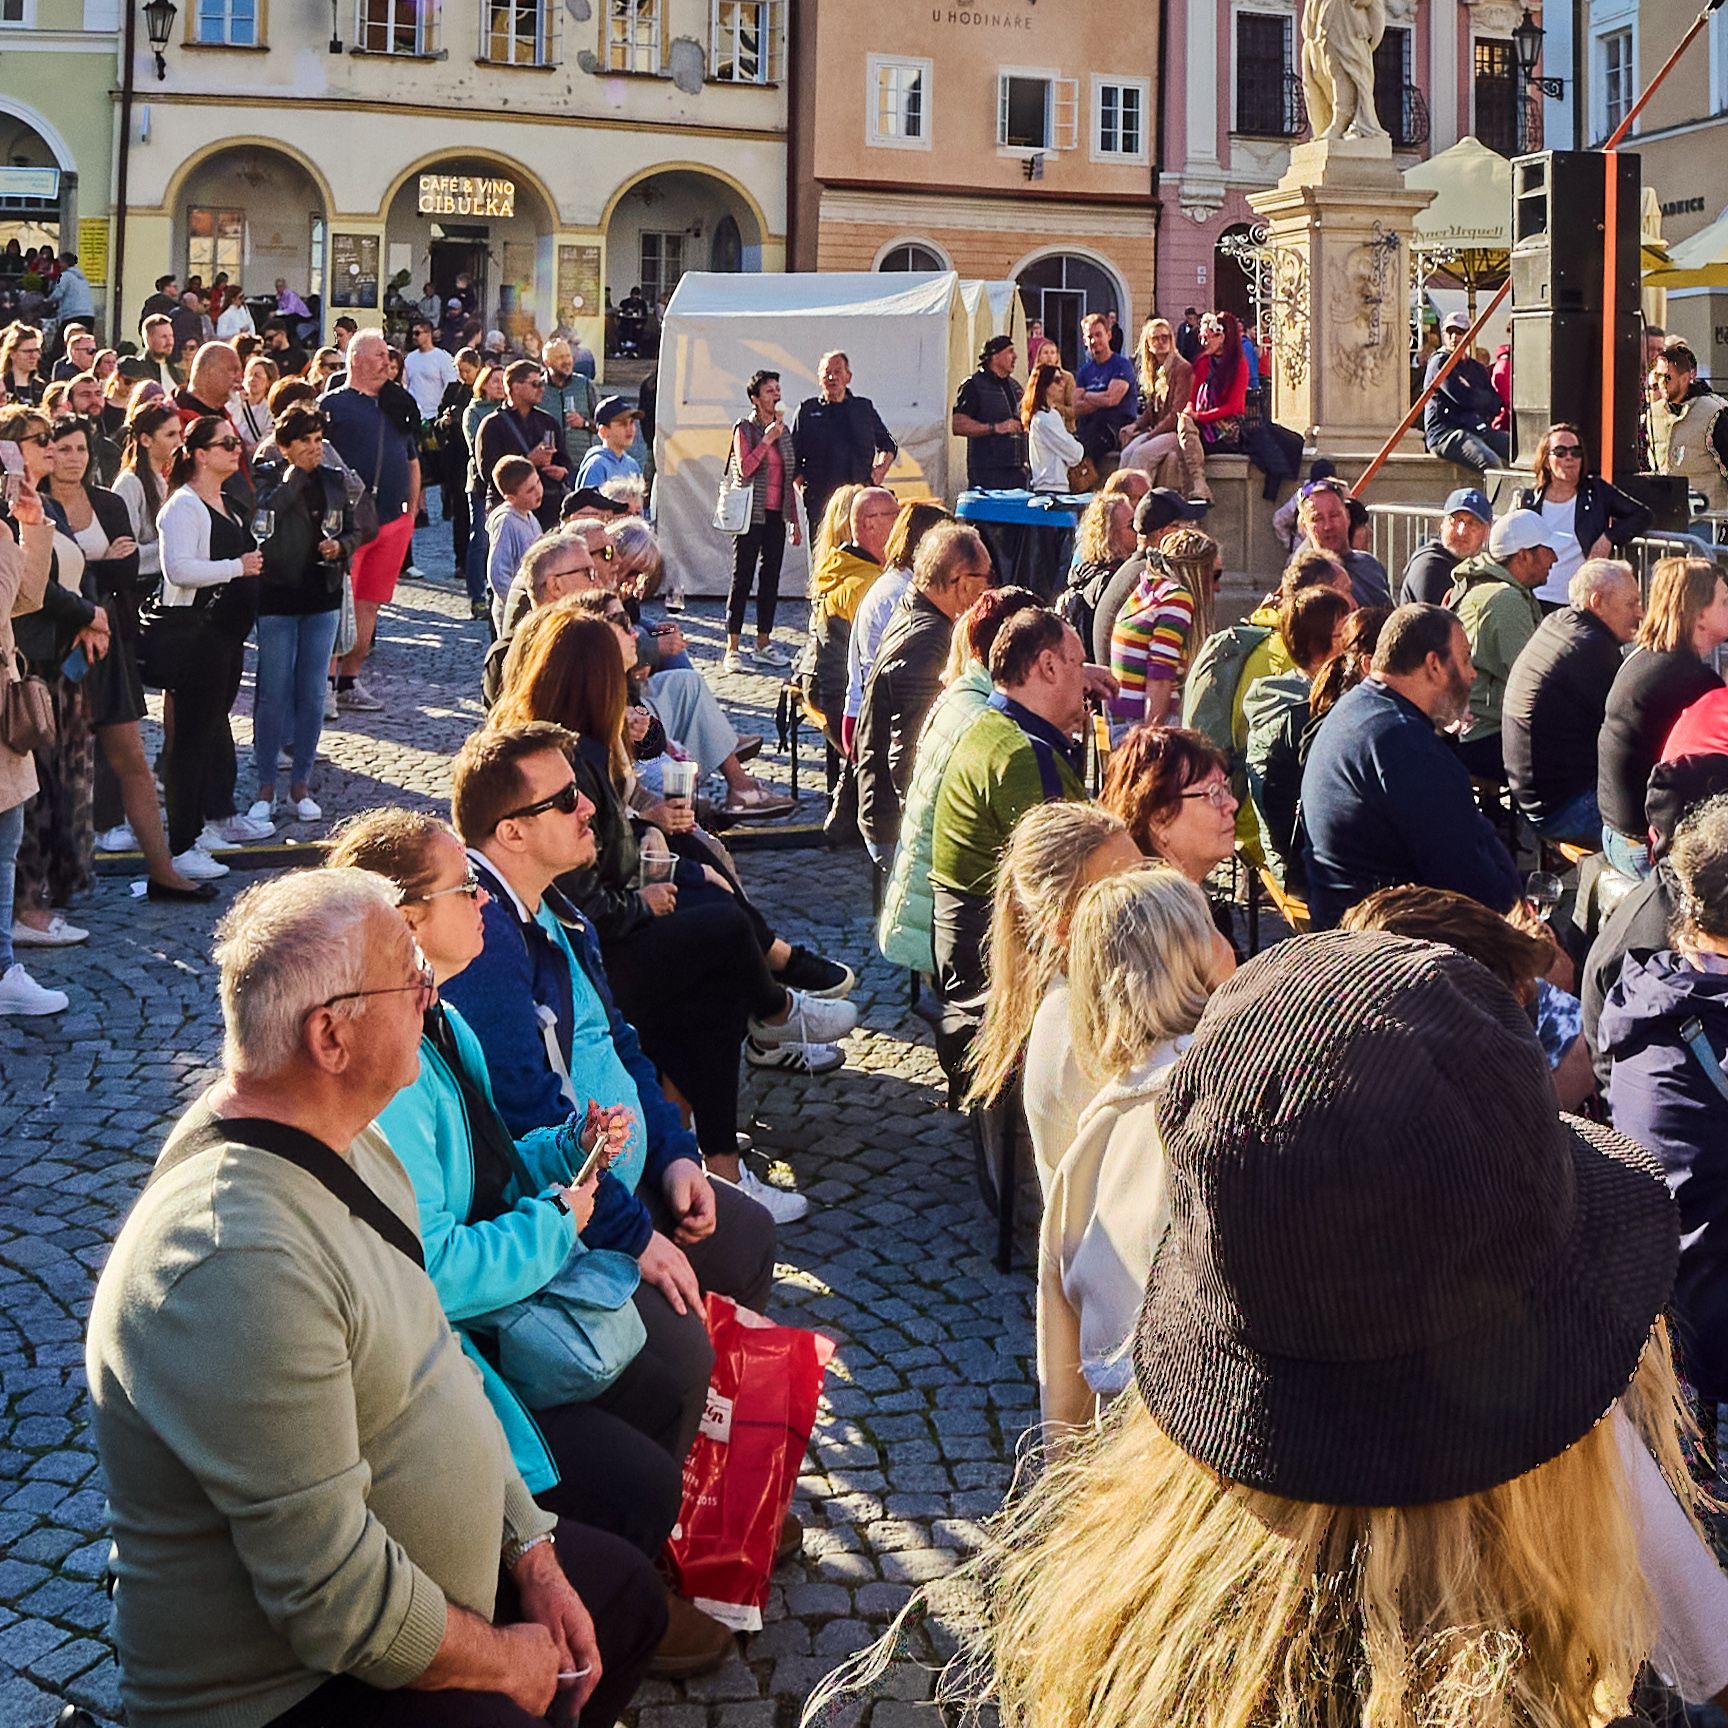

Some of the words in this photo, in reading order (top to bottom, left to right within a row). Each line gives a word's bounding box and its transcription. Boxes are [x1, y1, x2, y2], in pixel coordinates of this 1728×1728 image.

[932, 9, 941, 23] U
[419, 176, 459, 193] CAFÉ
[463, 179, 473, 193] &
[418, 195, 515, 218] CIBULKA
[696, 1494, 718, 1506] 2015
